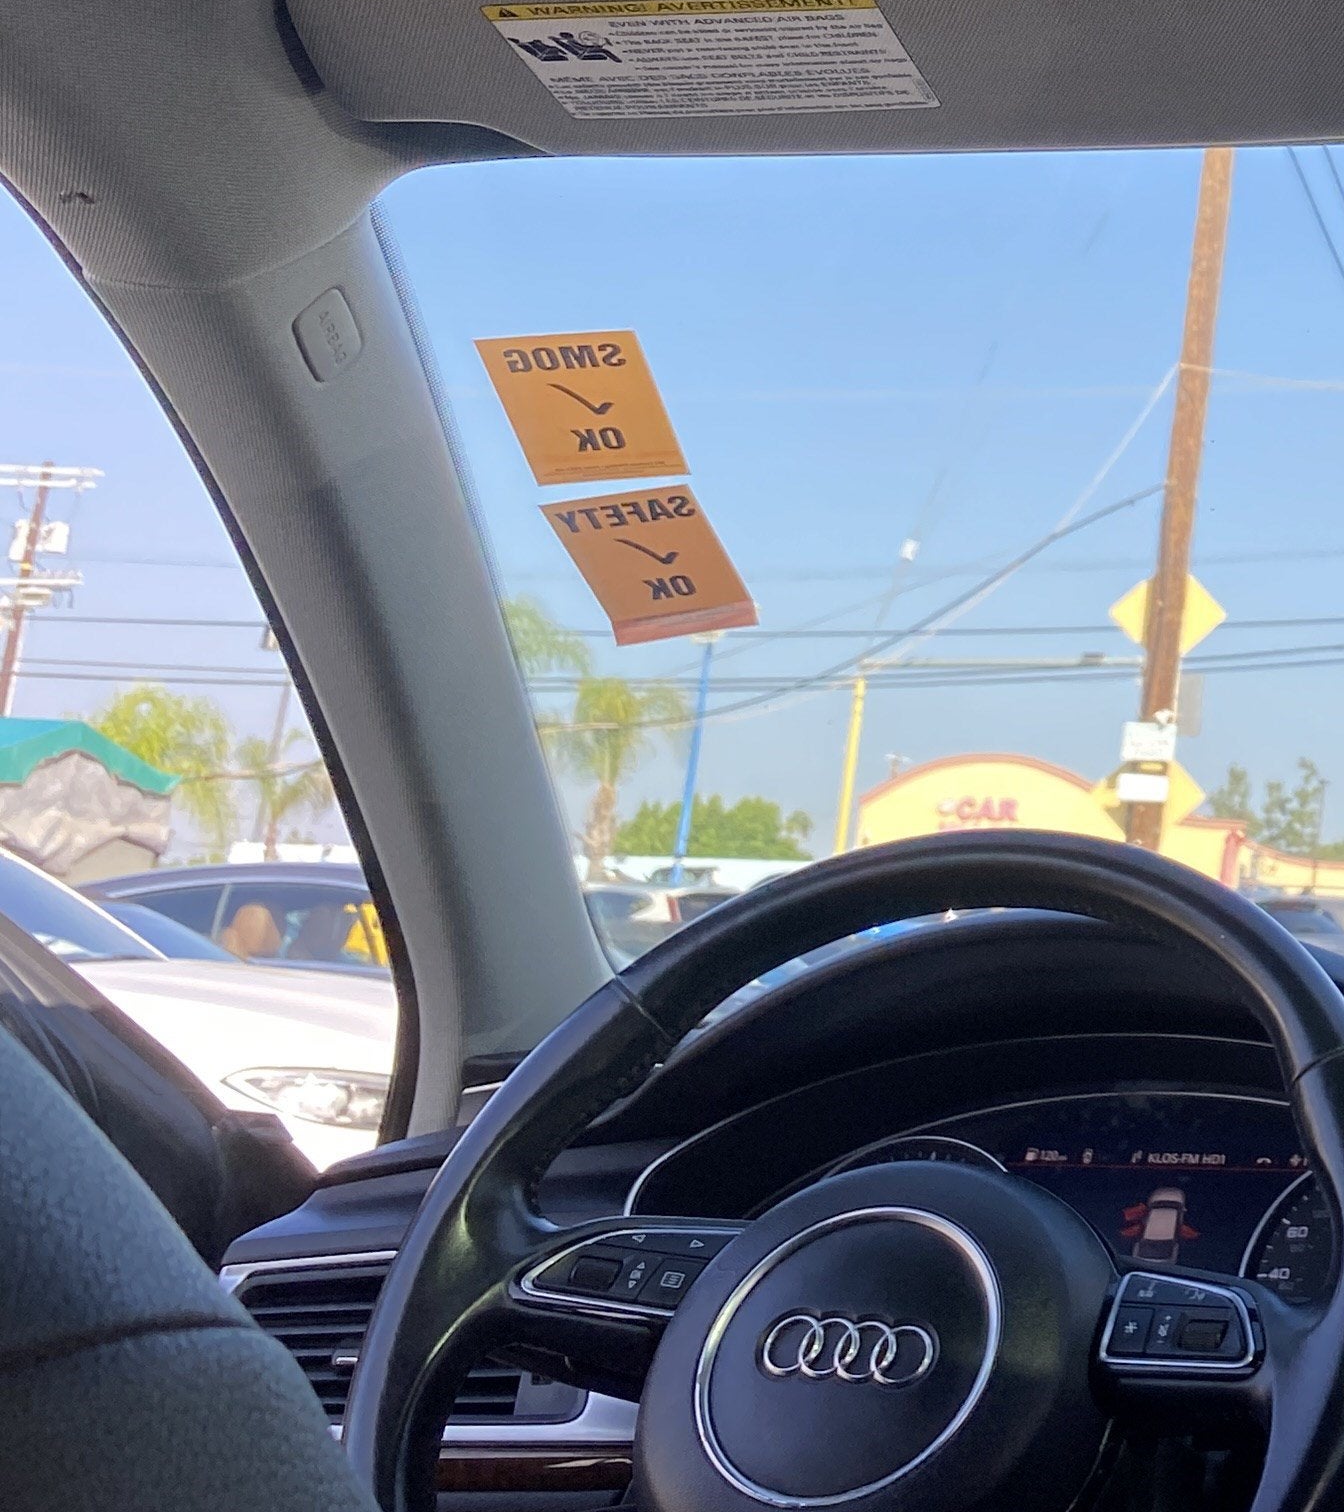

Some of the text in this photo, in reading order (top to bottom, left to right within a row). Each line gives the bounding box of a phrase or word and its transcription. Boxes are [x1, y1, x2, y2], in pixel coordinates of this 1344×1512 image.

[525, 3, 650, 17] WARNING!
[1147, 1152, 1200, 1165] KLOS-FM
[1286, 1226, 1309, 1239] 60
[1267, 1268, 1291, 1279] 40
